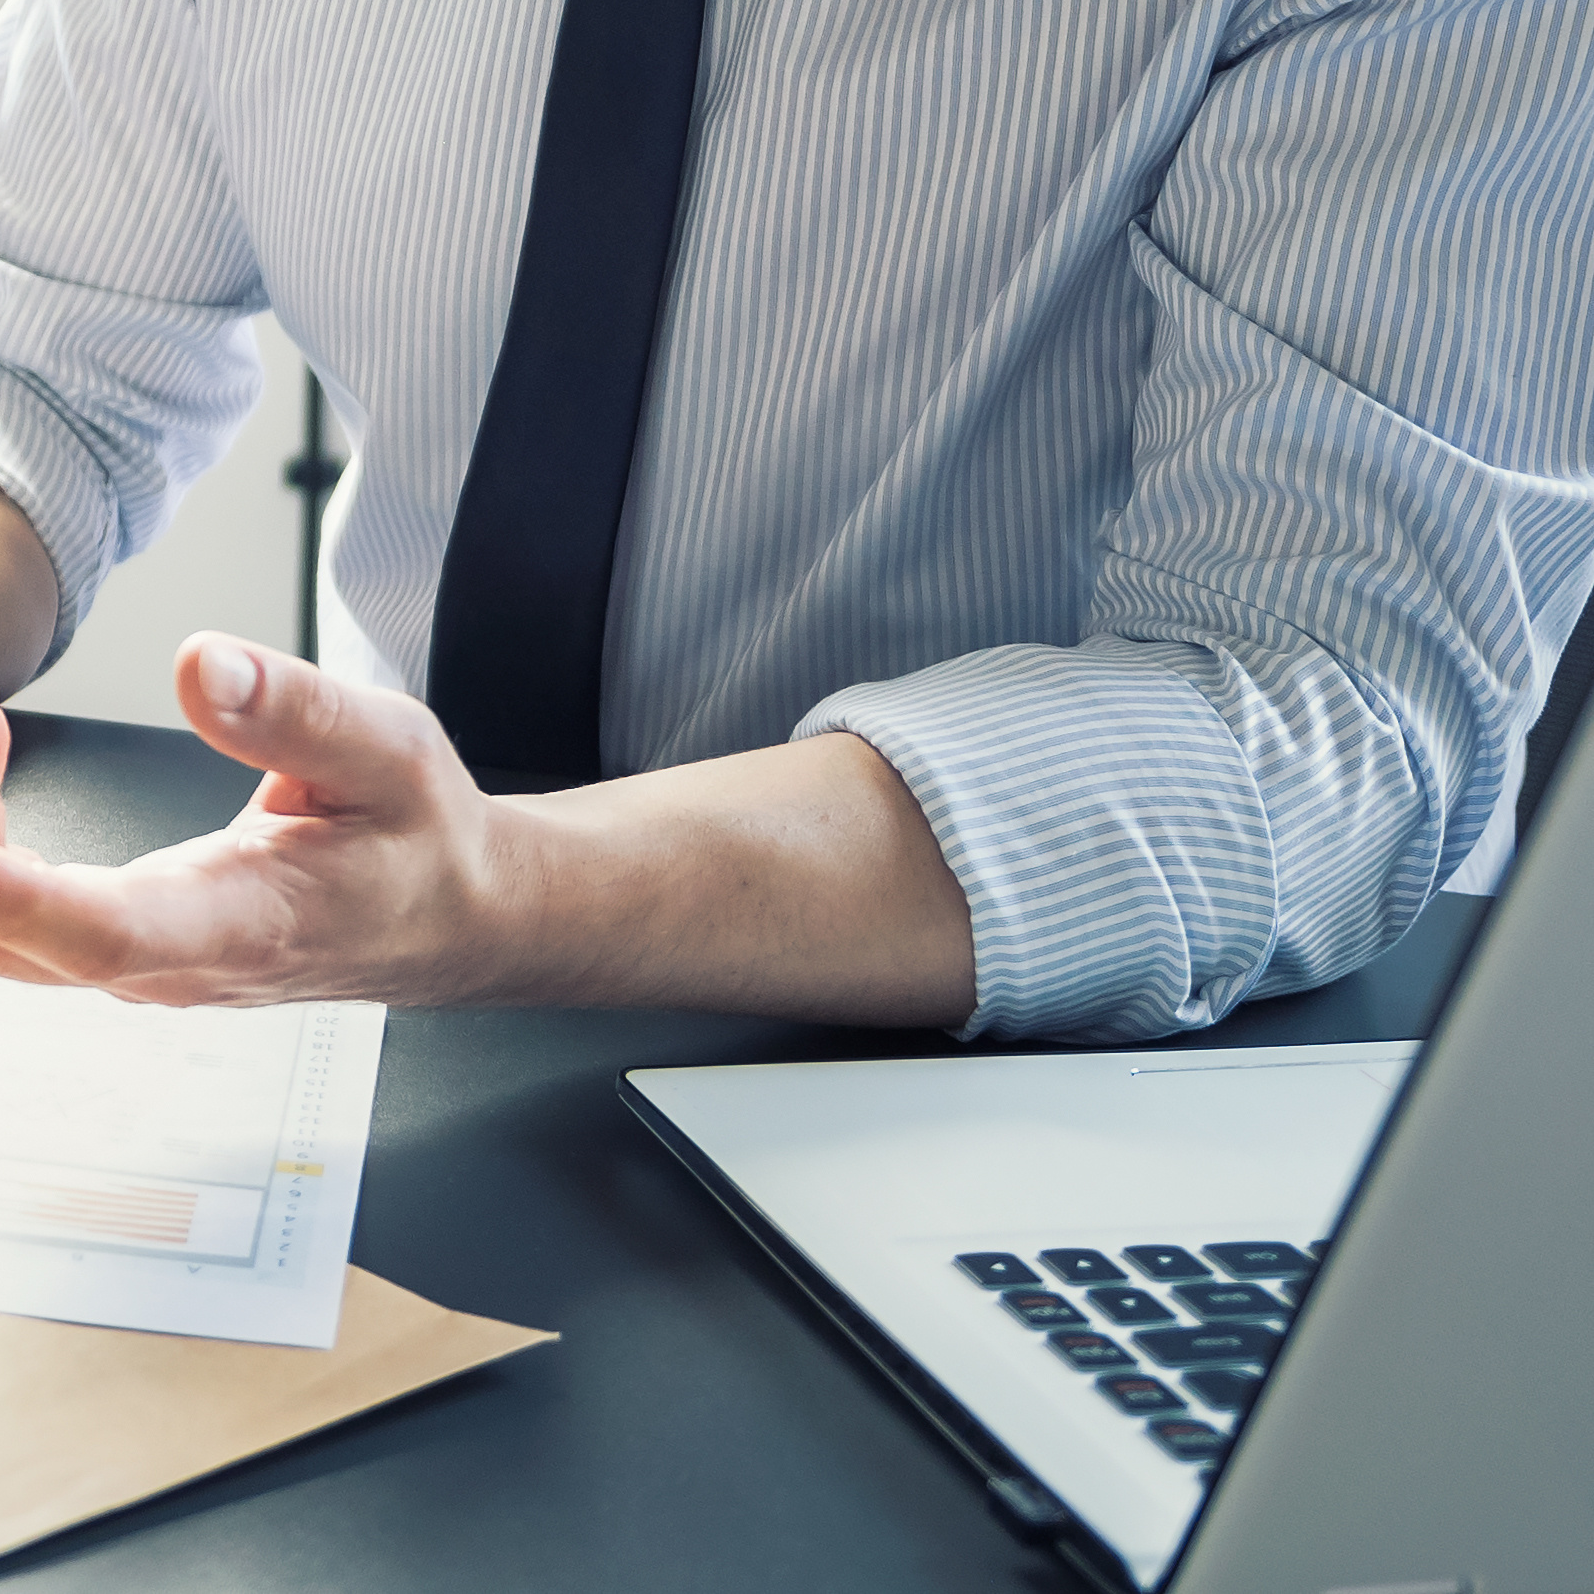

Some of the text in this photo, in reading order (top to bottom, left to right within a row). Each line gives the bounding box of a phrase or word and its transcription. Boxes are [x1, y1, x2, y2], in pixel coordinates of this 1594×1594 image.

[316, 1016, 339, 1026] 20
[314, 1030, 336, 1038] 19
[312, 1042, 333, 1051] 18
[310, 1055, 331, 1063] 17
